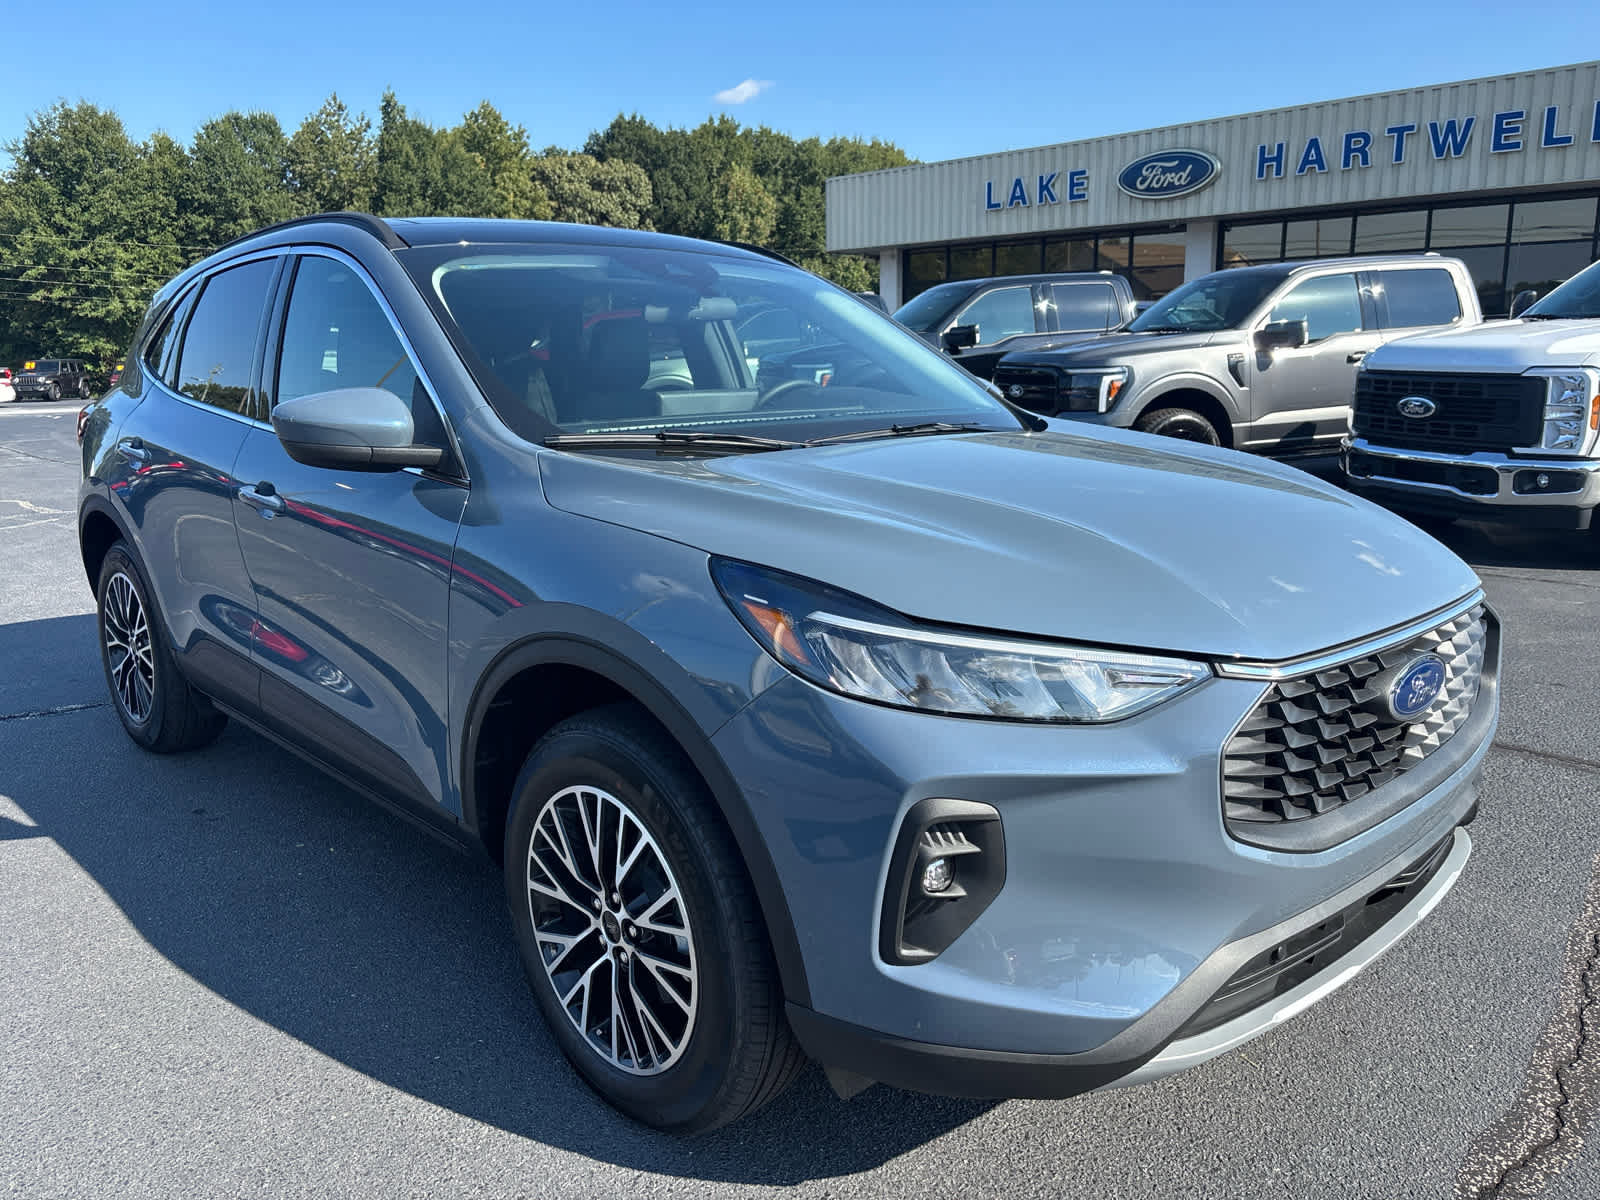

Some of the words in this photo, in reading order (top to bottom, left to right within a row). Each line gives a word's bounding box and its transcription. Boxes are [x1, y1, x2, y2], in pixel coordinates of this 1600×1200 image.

[985, 169, 1089, 211] LAKE
[1136, 160, 1192, 190] Ford
[1408, 670, 1439, 708] Ford
